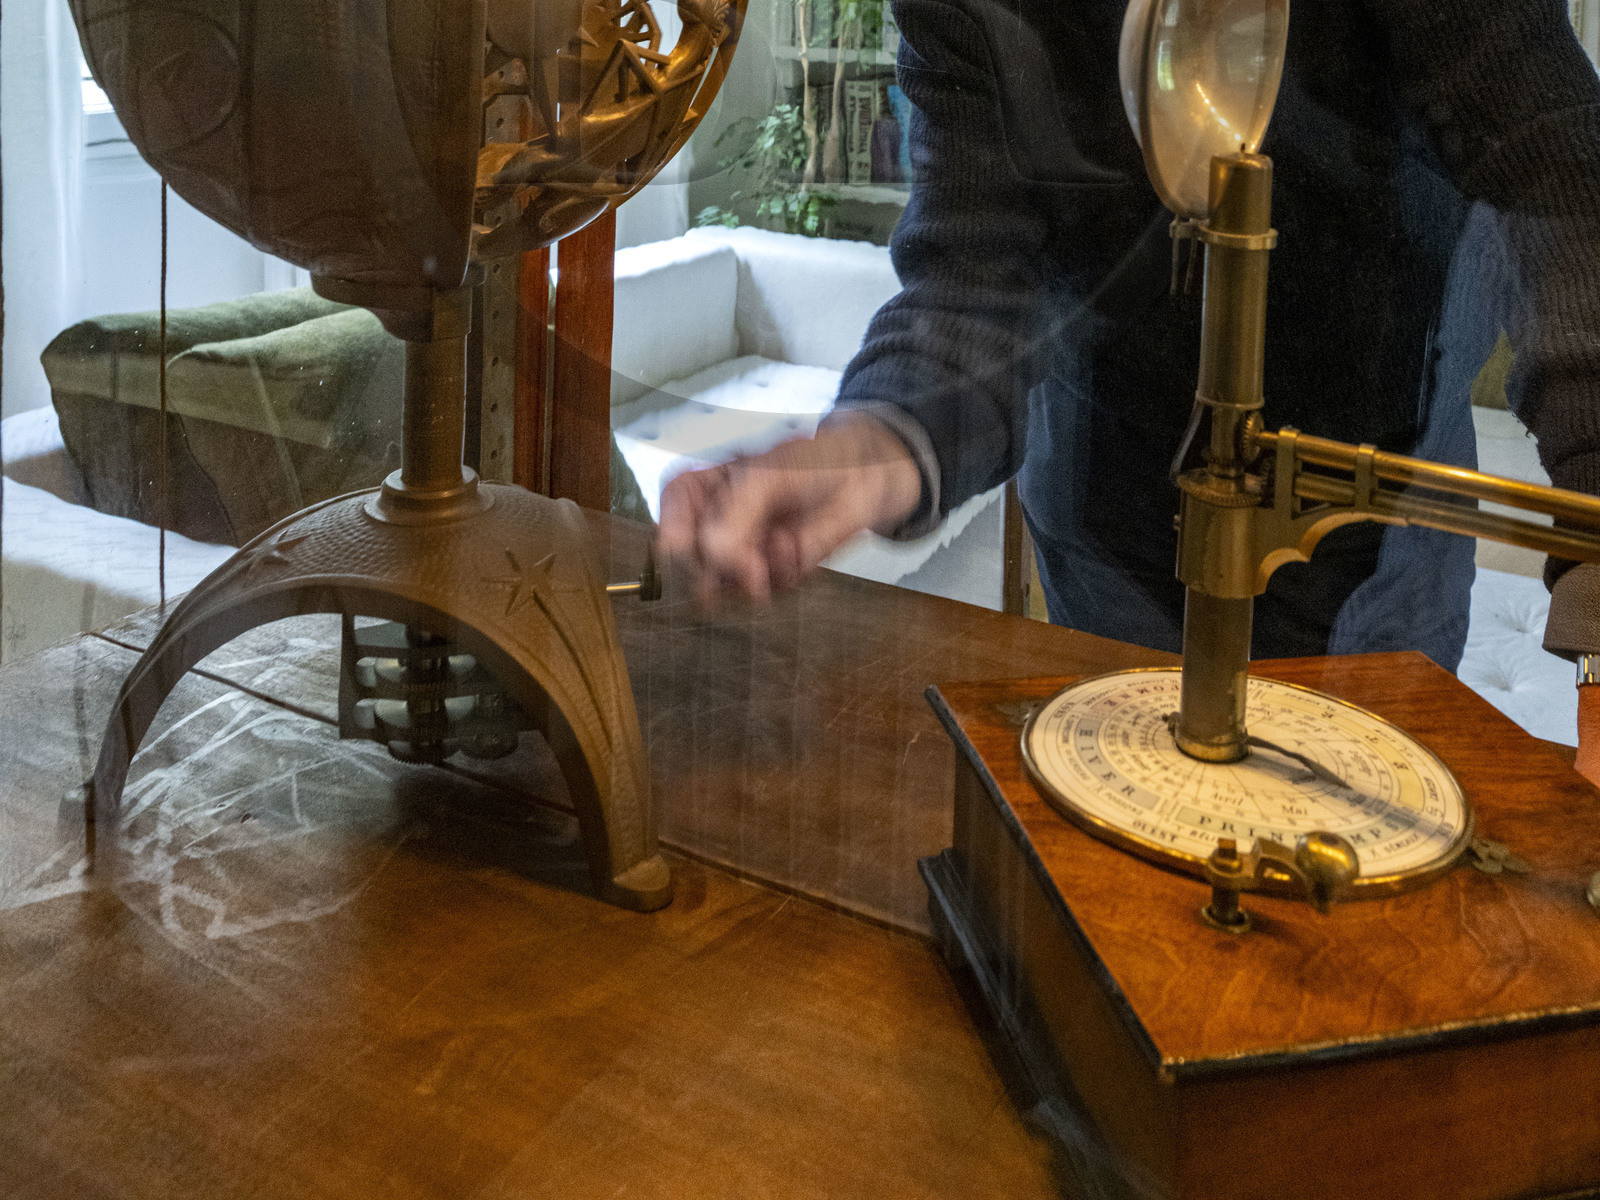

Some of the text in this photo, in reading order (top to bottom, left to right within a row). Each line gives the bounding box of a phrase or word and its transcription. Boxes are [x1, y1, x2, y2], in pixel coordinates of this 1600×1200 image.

[1078, 728, 1135, 797] HIVER
[1212, 792, 1244, 806] Avril
[1281, 805, 1309, 816] Mai
[1132, 819, 1178, 843] OUEST
